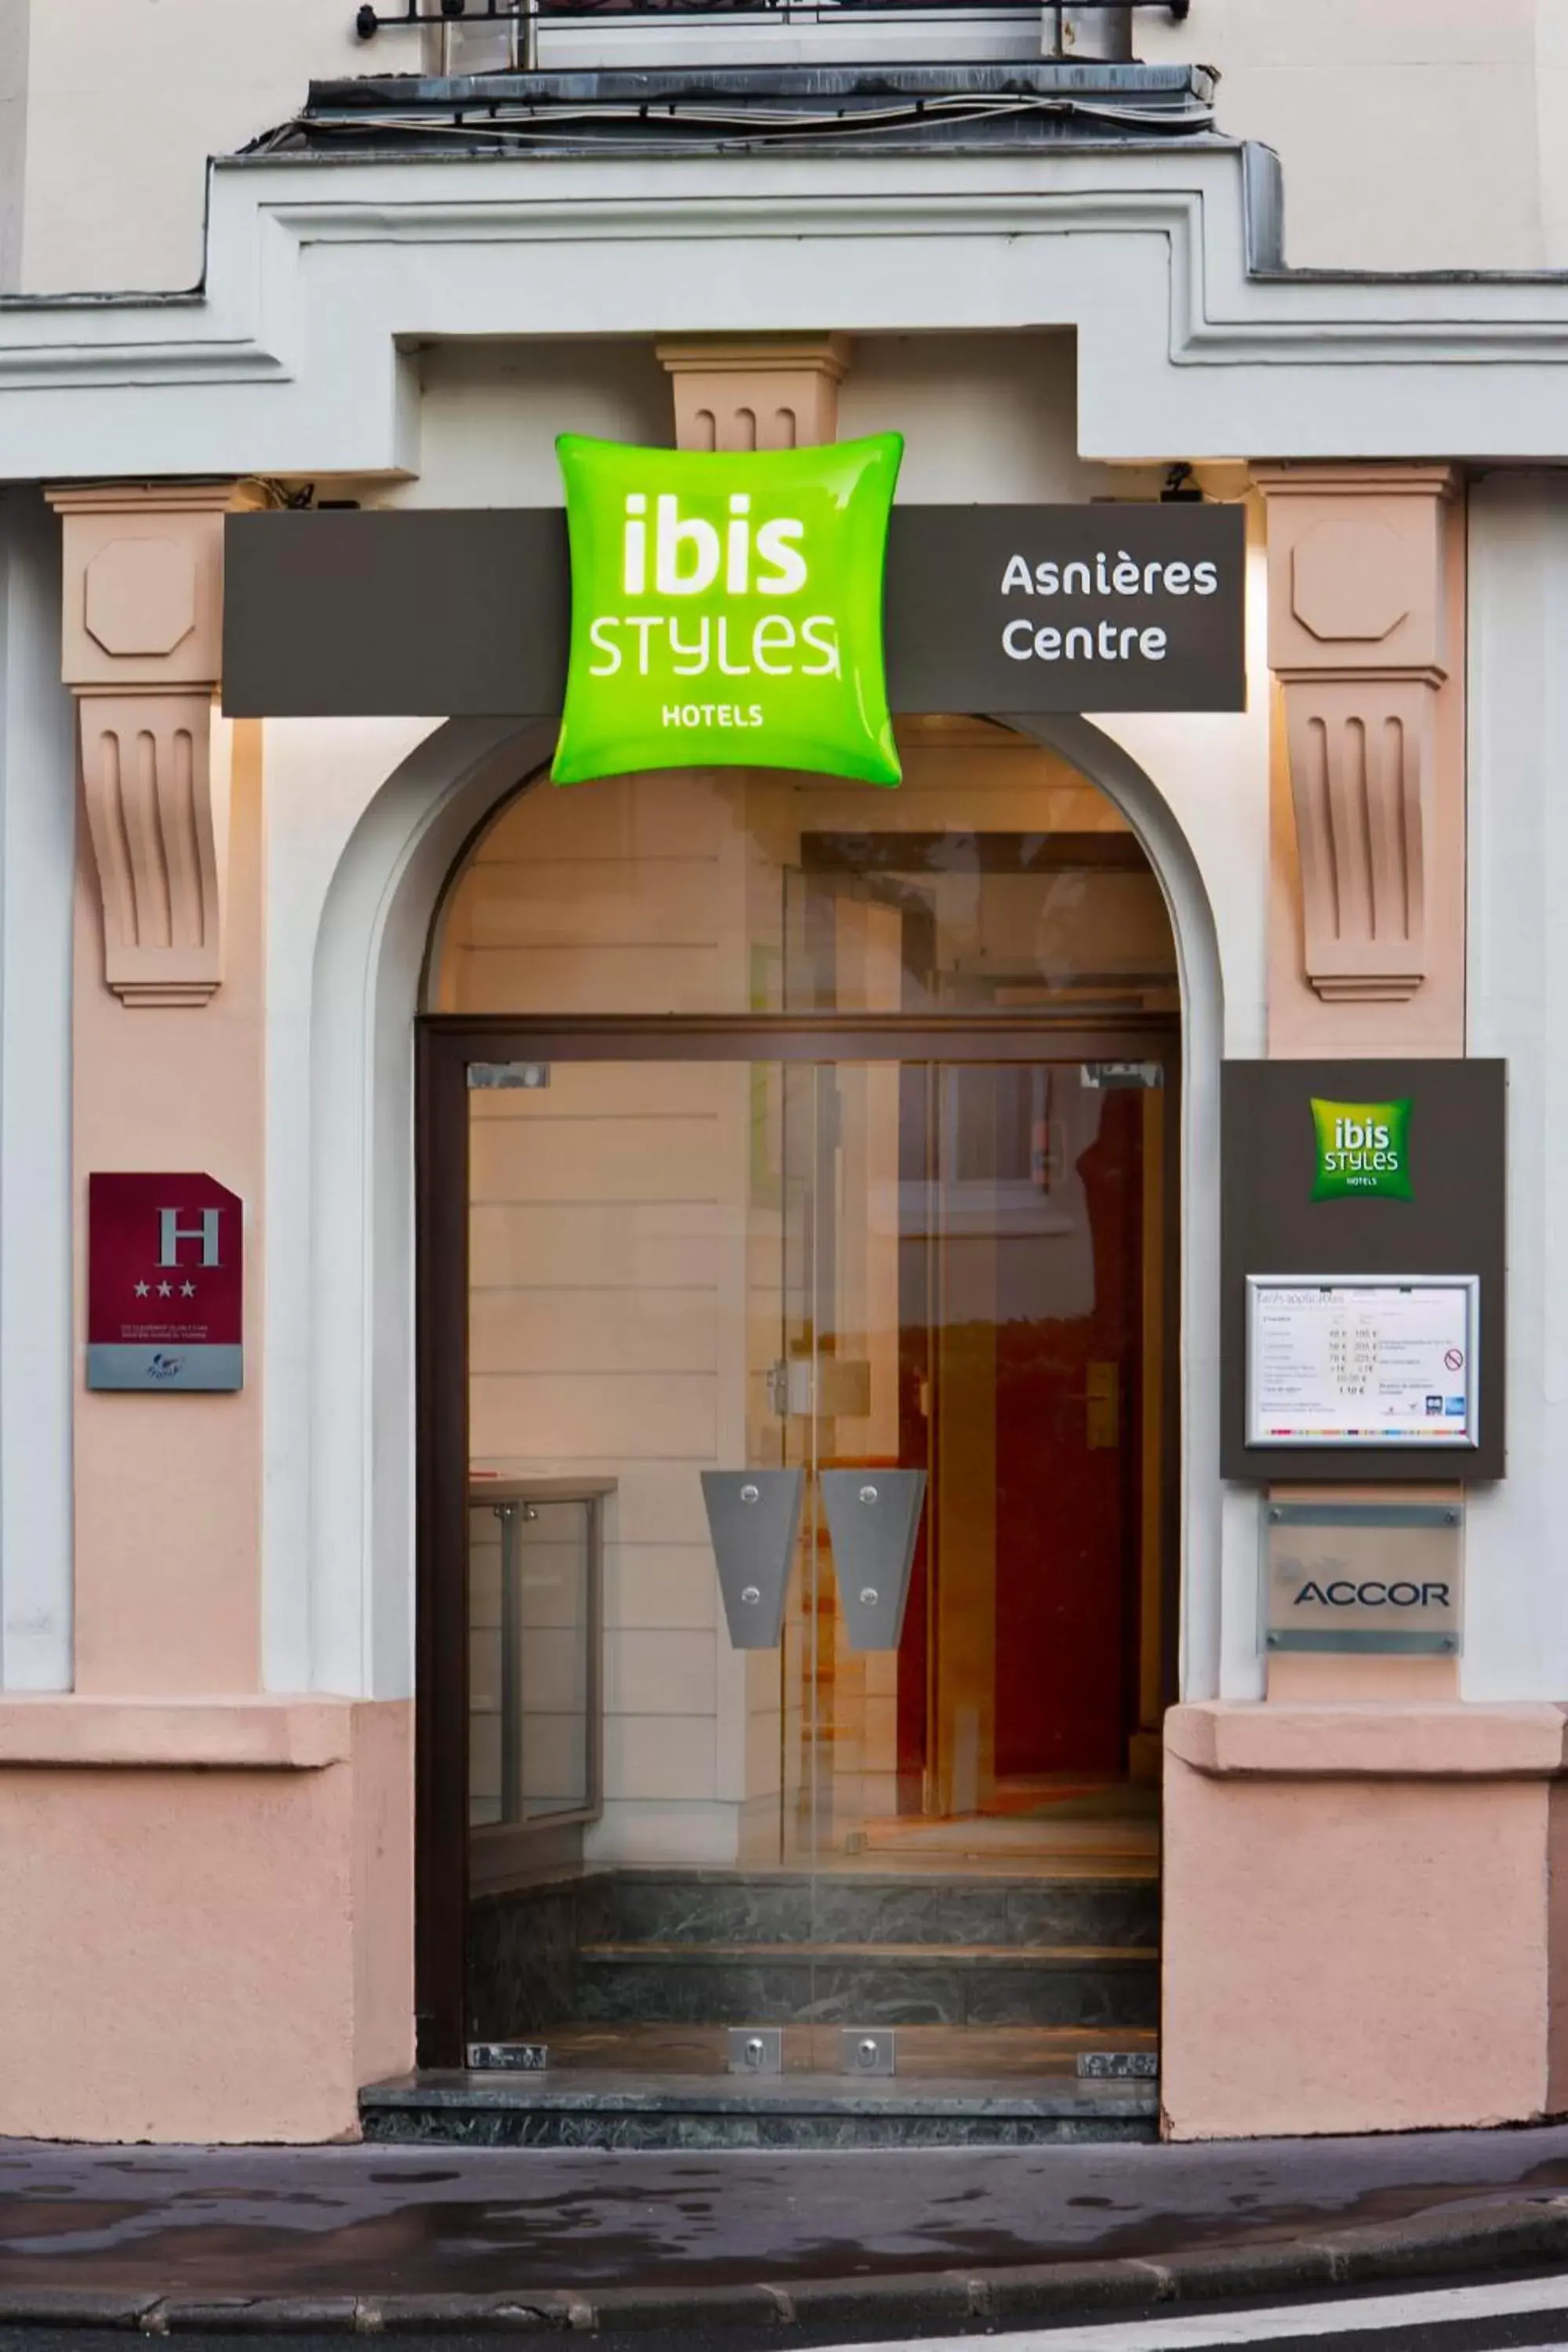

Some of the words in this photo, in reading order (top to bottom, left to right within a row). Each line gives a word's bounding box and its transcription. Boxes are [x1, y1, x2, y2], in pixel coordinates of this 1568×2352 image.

[623, 493, 808, 595] ibis
[1000, 550, 1218, 595] Asnières
[1001, 619, 1167, 661] Centre
[662, 704, 763, 727] HOTELS
[1335, 1118, 1389, 1149] ibis
[1346, 1177, 1377, 1185] HOTELS
[154, 1207, 226, 1267] H
[1294, 1581, 1450, 1607] ACCOR
